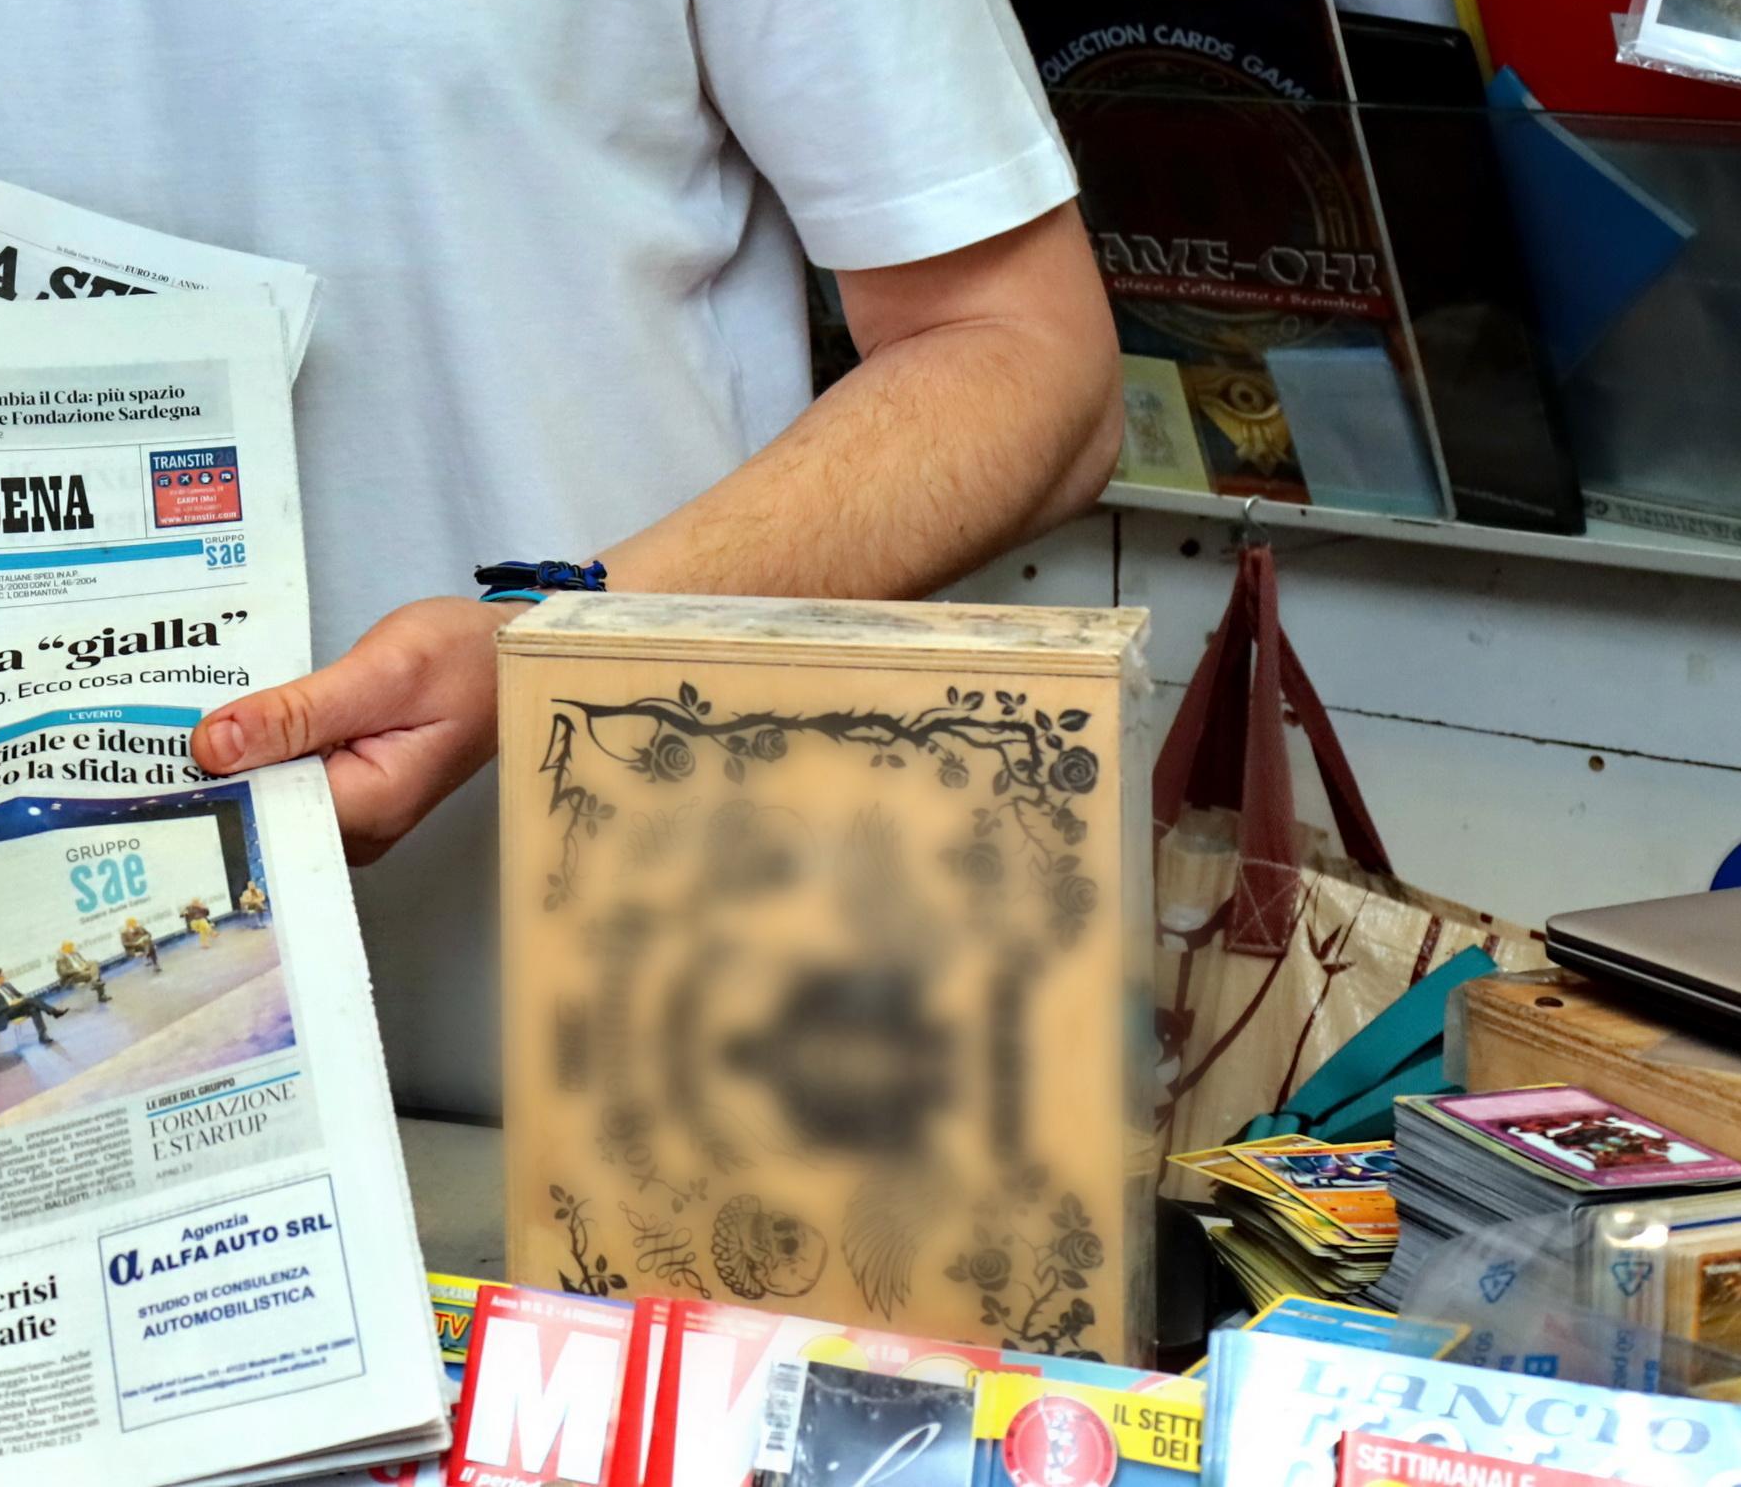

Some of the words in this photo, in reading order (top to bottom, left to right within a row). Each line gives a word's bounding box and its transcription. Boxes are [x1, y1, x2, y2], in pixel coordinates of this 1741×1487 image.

[1153, 25, 1235, 61] CARDS
[1098, 233, 1381, 296] AME-OH!
[128, 385, 185, 405] spazio
[12, 409, 115, 426] Fondazione
[118, 405, 201, 425] Sardegna
[152, 453, 214, 470] TRANSTIR
[18, 677, 71, 699] Ecco
[79, 672, 133, 690] cosa
[139, 664, 250, 687] cambierà
[61, 761, 138, 786] sfida
[66, 838, 141, 863] GRUPPO
[70, 853, 148, 913] sae
[150, 1081, 297, 1138] FORMAZIONE
[181, 1213, 249, 1242] Agenzia
[150, 1245, 209, 1275] ALFA
[213, 1226, 279, 1257] AUTO
[286, 1213, 332, 1238] SRL
[212, 1265, 310, 1300] CONSULENZA
[143, 1285, 316, 1340] AUTOMOBILISTICA
[1113, 1404, 1130, 1429] IL
[1152, 1437, 1186, 1463] DEI
